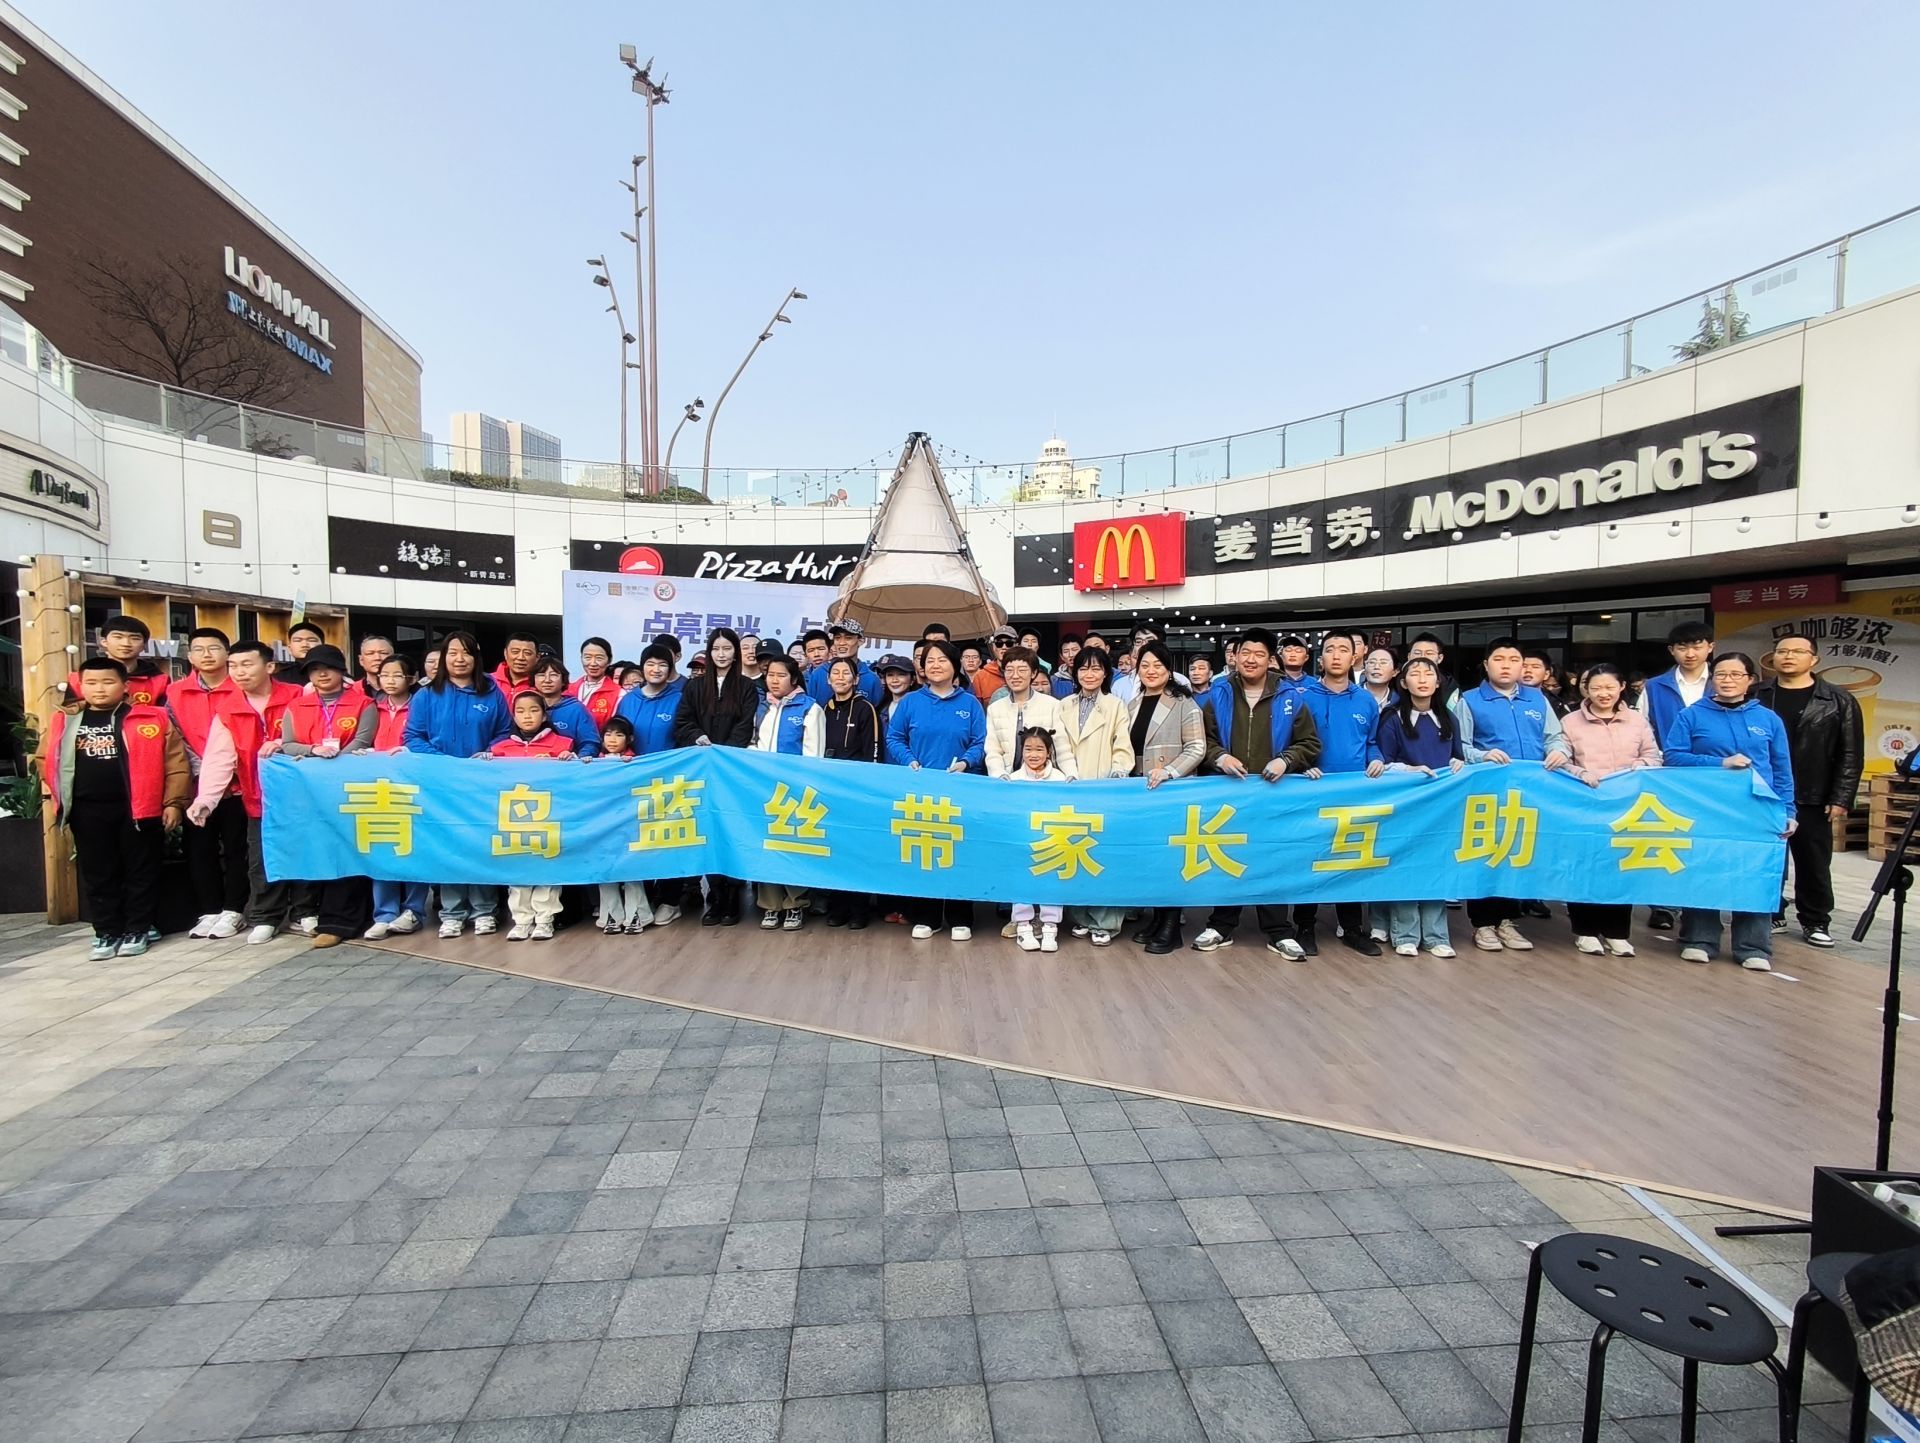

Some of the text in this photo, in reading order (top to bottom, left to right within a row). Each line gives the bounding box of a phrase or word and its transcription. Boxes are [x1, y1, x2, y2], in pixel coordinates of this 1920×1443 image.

[285, 329, 334, 376] IMAX
[1408, 430, 1757, 536] McDonald's
[1214, 505, 1374, 564] 麦当劳
[694, 551, 851, 581] Pizza Hut
[1733, 584, 1809, 604] 麦当劳
[339, 775, 1694, 880] 青岛蓝丝带家长互助会
